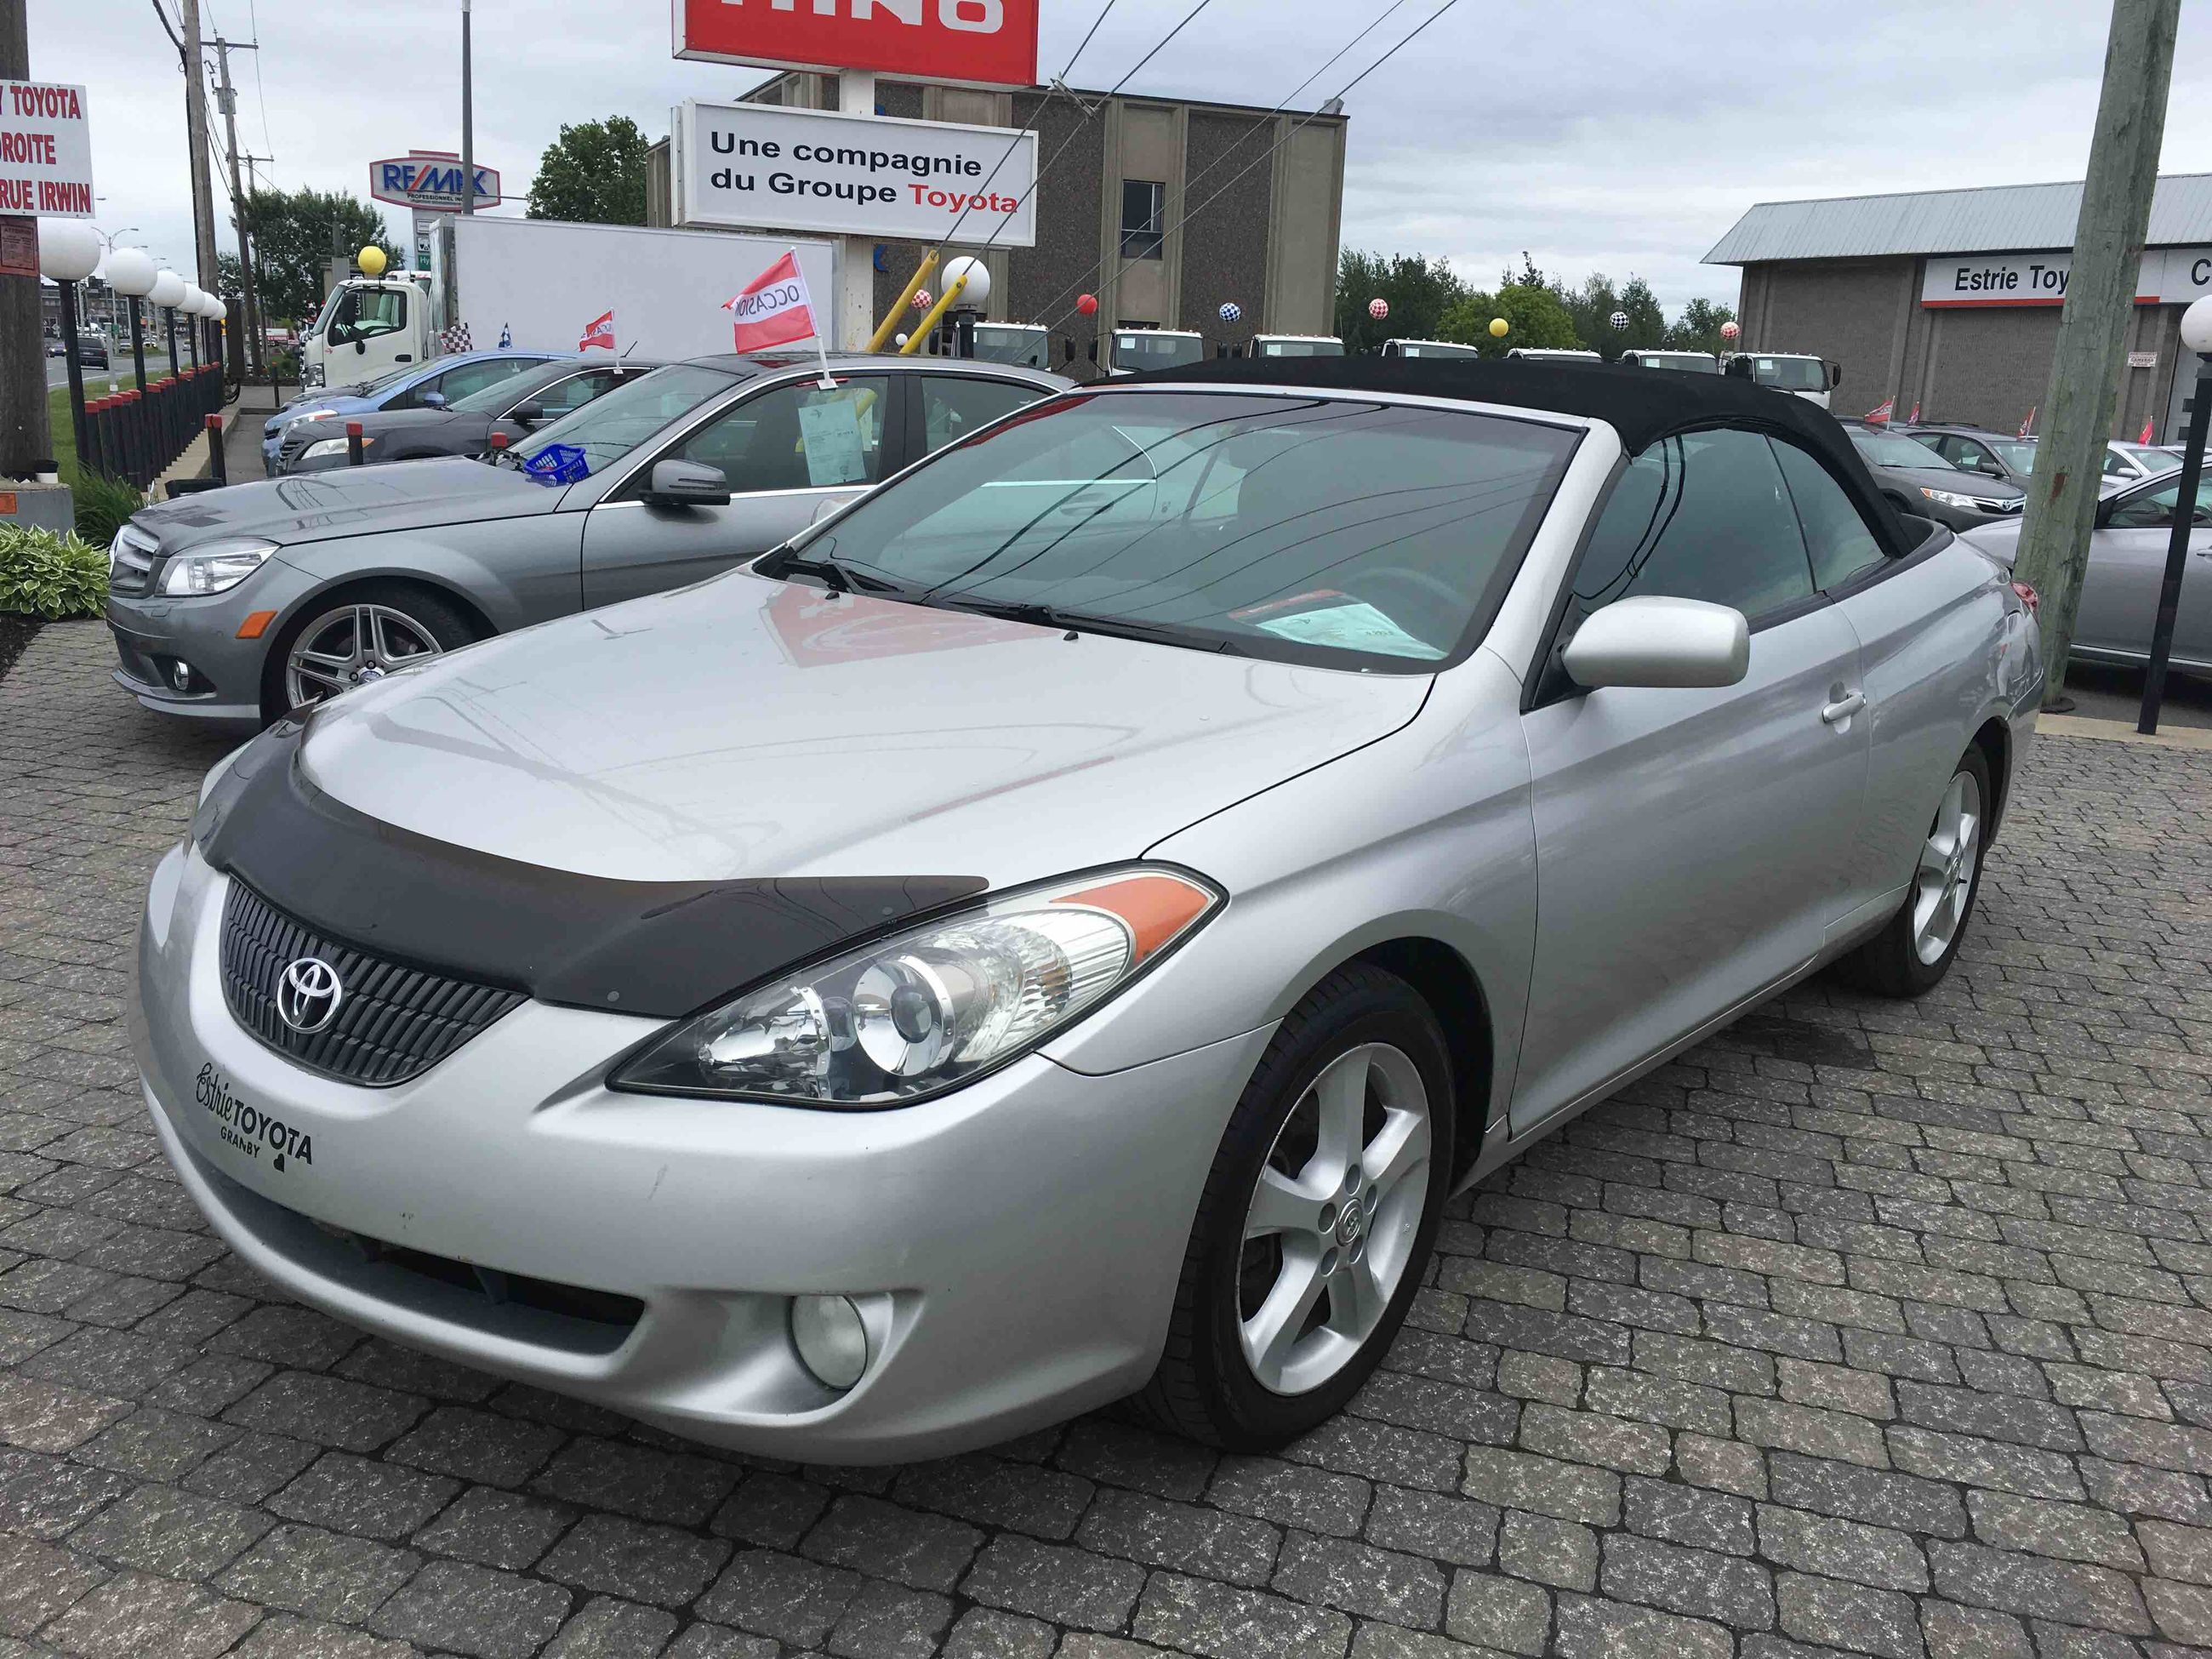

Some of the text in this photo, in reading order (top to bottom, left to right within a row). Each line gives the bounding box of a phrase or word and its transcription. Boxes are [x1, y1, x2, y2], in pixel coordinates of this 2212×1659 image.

[721, 0, 1003, 33] NO
[10, 85, 81, 119] TOYOTA
[0, 132, 56, 164] ROITE
[711, 131, 982, 177] Une compagnie
[38, 181, 91, 213] IRWIN
[710, 168, 1018, 214] du Groupe Toyota
[1954, 267, 2018, 290] Estrie
[197, 1063, 312, 1165] Estrie TOYOTA
[220, 1126, 260, 1158] GRANBY
